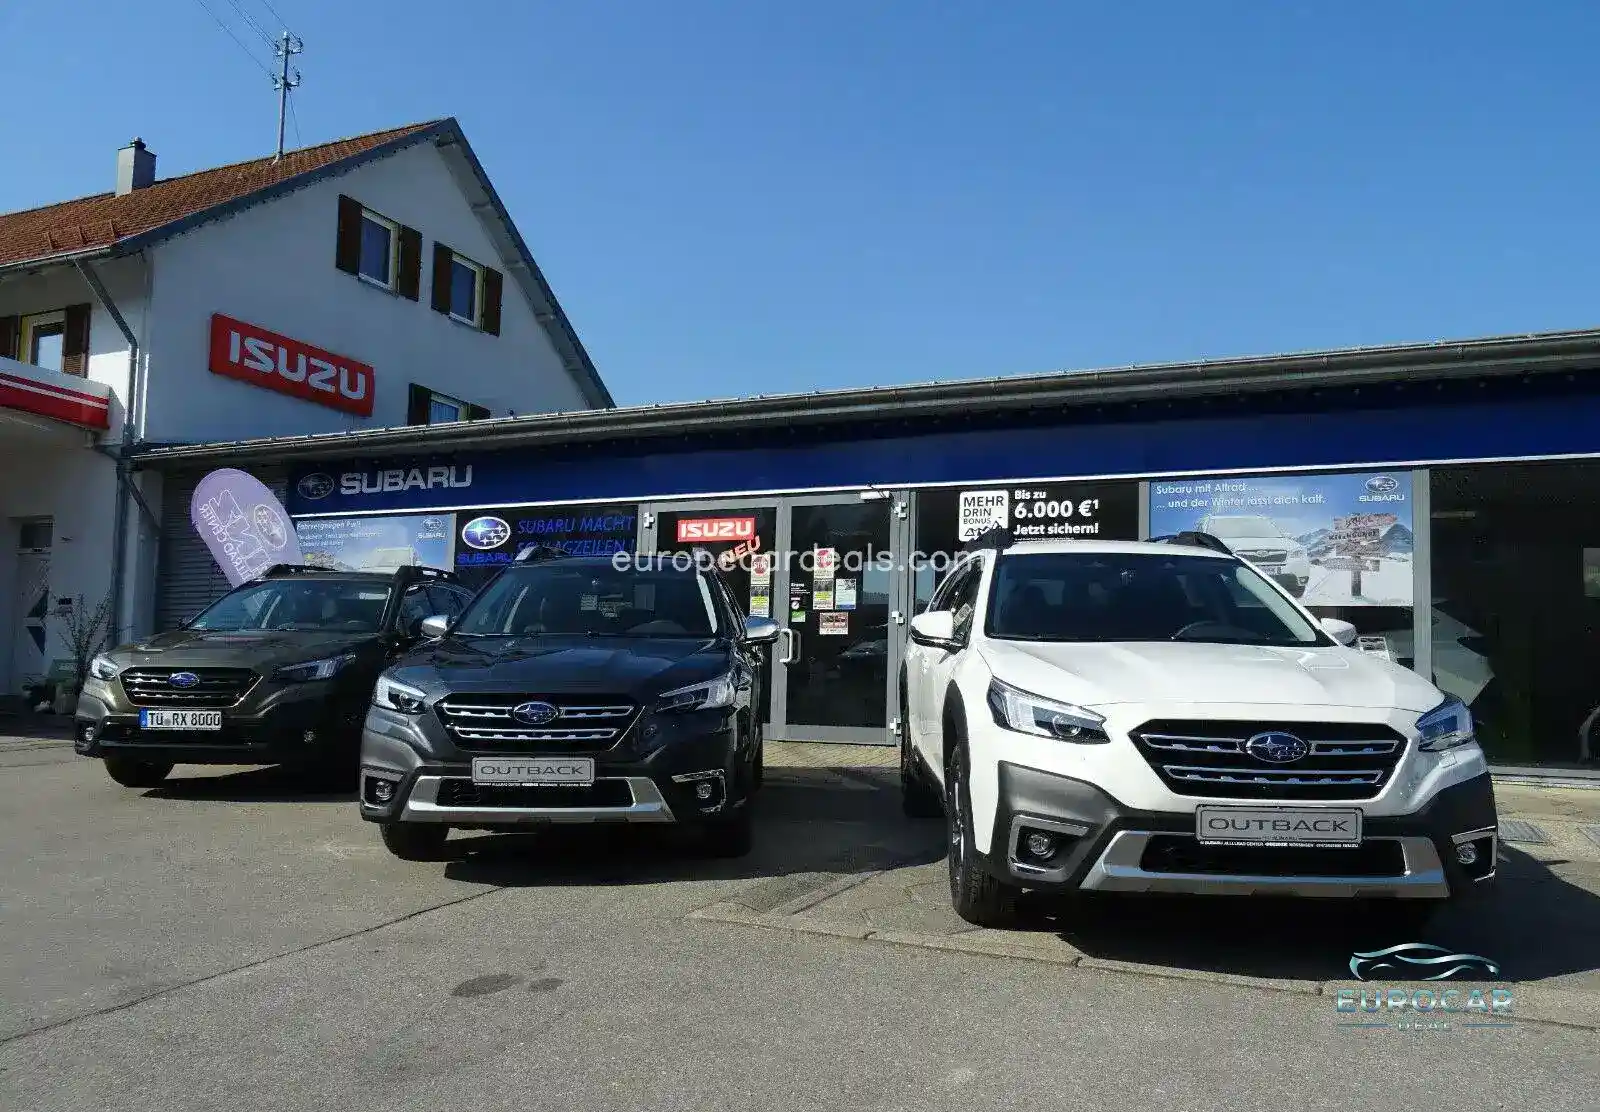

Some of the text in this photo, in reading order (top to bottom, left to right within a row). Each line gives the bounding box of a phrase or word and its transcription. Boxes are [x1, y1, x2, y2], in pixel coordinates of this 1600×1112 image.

[229, 330, 366, 400] ISUZU
[340, 465, 472, 495] SUBARU
[1014, 489, 1047, 500] Bis zu
[1156, 485, 1192, 495] Subaru
[1195, 485, 1212, 494] mit
[1215, 483, 1247, 493] Allrad
[963, 496, 1005, 507] MEHR
[1168, 500, 1188, 508] und
[1190, 498, 1208, 507] der
[1359, 494, 1405, 502] SUBARU
[963, 508, 992, 517] DRIN
[1014, 500, 1073, 519] 6.000
[519, 516, 636, 533] SUBARU MACHT
[963, 517, 992, 525] BONUS
[681, 521, 752, 538] ISUZU
[1013, 523, 1099, 535] Jetzt sichern!
[172, 713, 187, 725] RX
[191, 713, 220, 726] 8000
[480, 766, 583, 775] OUTBACK
[1208, 818, 1349, 832] OUTBACK
